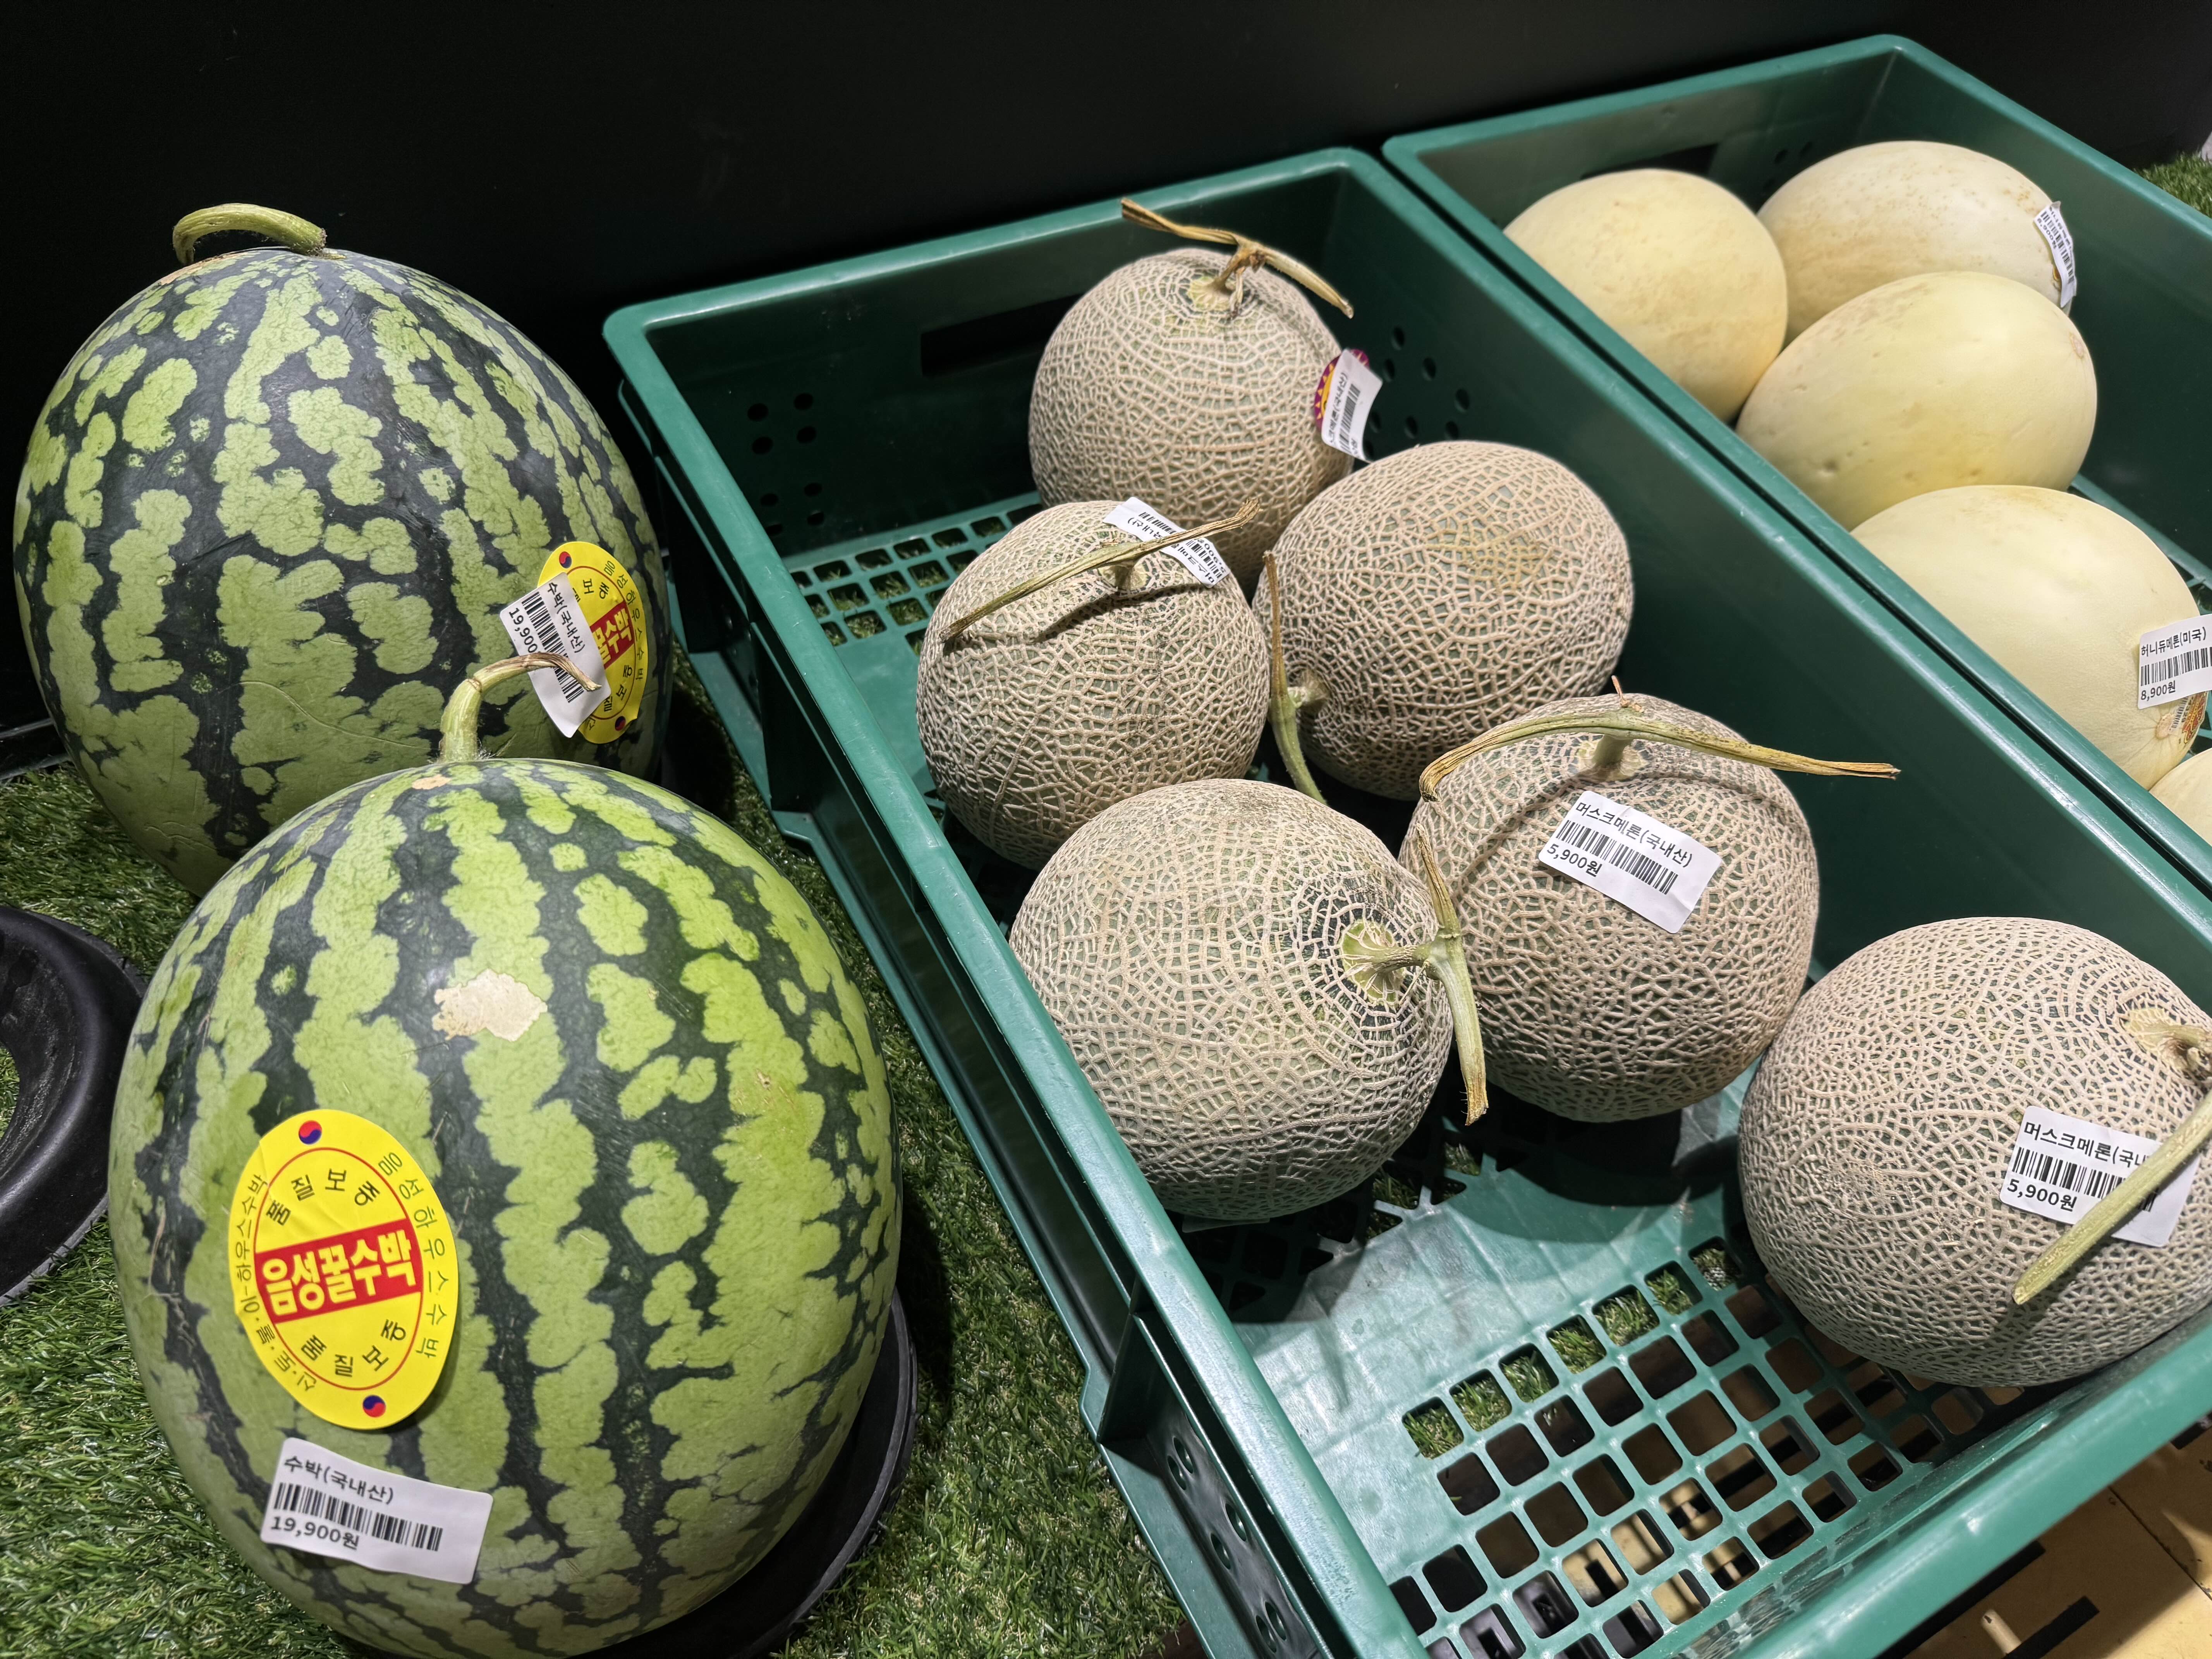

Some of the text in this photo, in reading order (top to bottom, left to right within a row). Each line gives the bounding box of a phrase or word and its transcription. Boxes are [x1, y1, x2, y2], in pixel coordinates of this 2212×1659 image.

[508, 607, 540, 654] 19,900
[547, 582, 586, 654] 수박(국내산)
[604, 560, 644, 680] 음성하우스수박
[2140, 680, 2176, 701] 8,900원
[1547, 843, 1602, 878] 5,900원
[1575, 802, 1693, 868] 머스크메론(국내산)
[266, 1168, 380, 1226] 품질보증
[2006, 1179, 2077, 1212] 5,900원
[262, 1229, 417, 1316] 음성꿀수박
[378, 1152, 450, 1359] 음성하우스수박
[301, 1318, 407, 1379] 품질보증
[284, 1455, 395, 1505] 수박(국내산)
[270, 1516, 359, 1551] 19,900원
